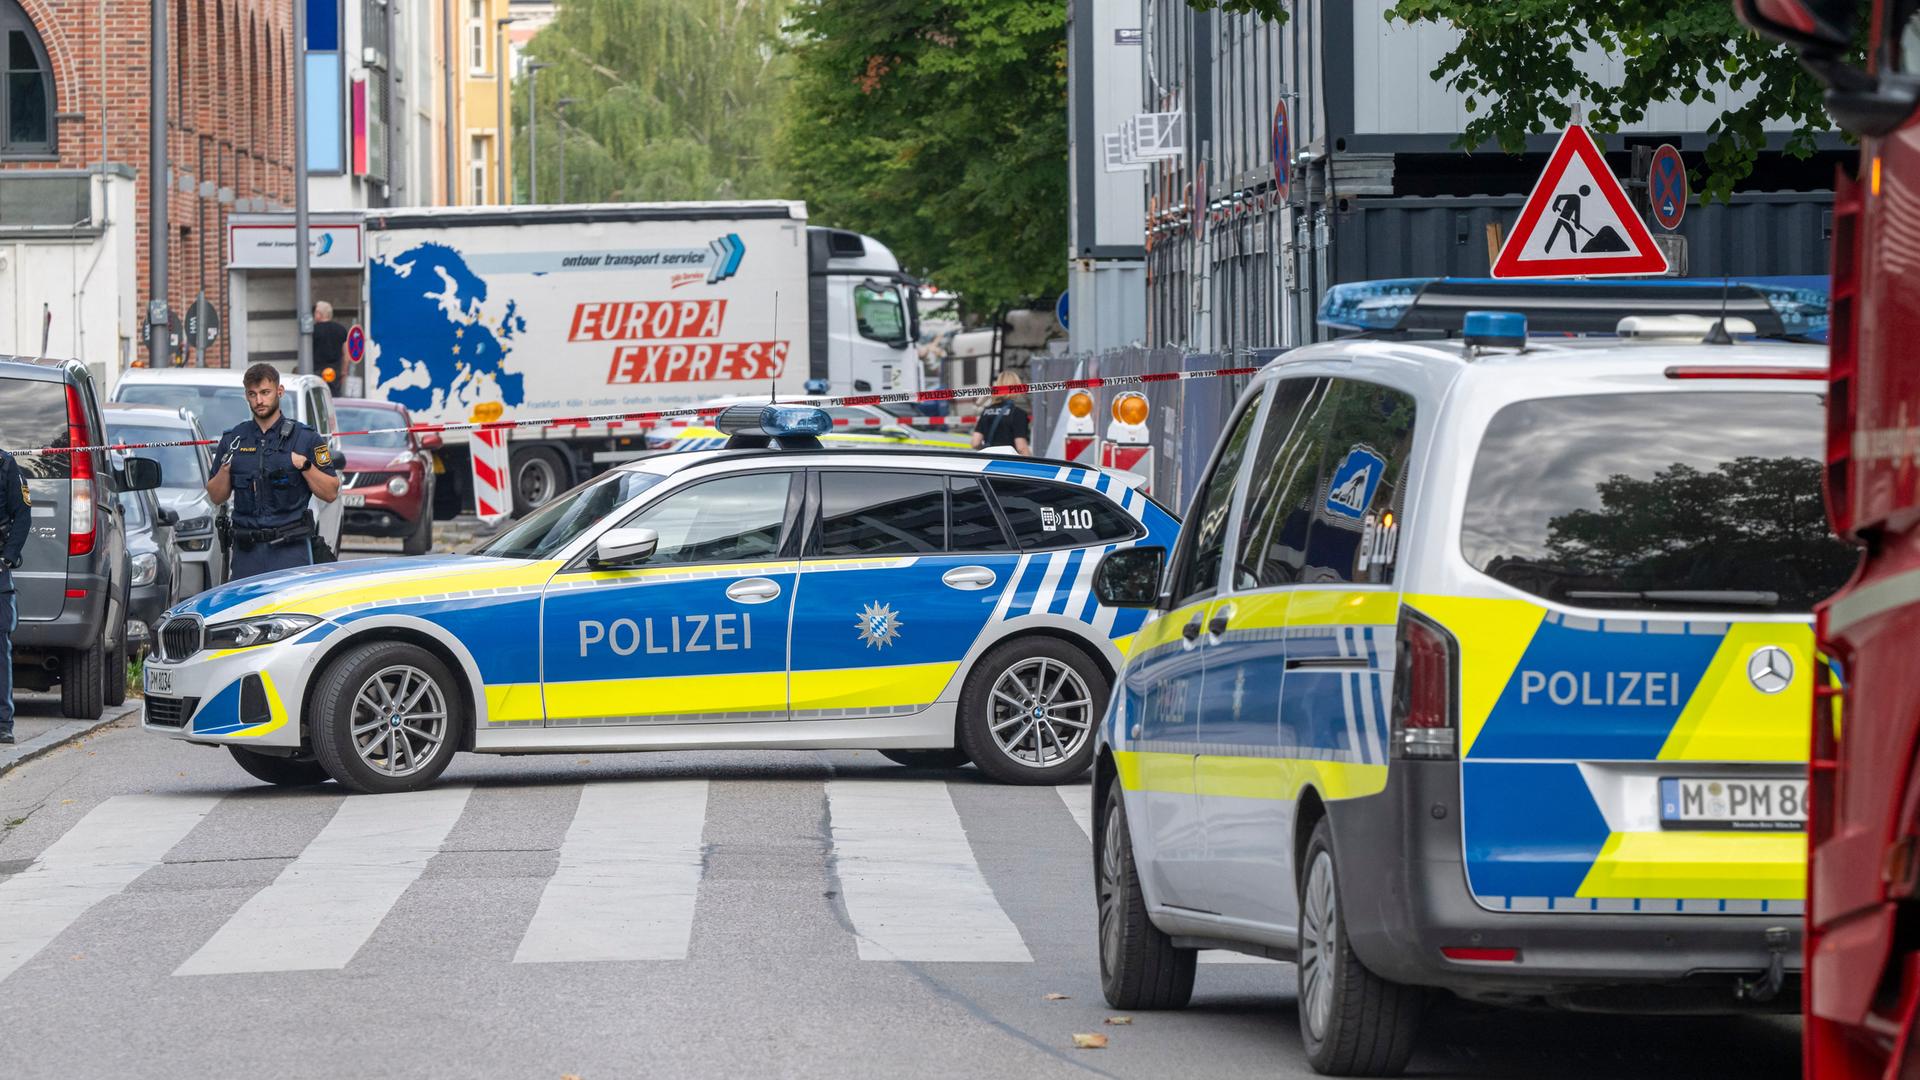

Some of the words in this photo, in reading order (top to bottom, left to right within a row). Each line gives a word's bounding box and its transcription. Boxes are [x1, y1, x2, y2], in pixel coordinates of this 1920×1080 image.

[561, 254, 602, 267] ontour
[604, 251, 660, 268] transport
[662, 251, 705, 265] service
[574, 300, 721, 341] EUROPA
[612, 341, 788, 384] EXPRESS
[831, 392, 909, 406] POLIZEIABSPERRUNG
[920, 386, 998, 400] POLIZEIABSPERRUNG
[1062, 508, 1093, 530] 110
[578, 612, 752, 657] POLIZEI
[1521, 670, 1679, 706] POLIZEI
[1682, 784, 1704, 816] M
[1727, 784, 1771, 816] PM
